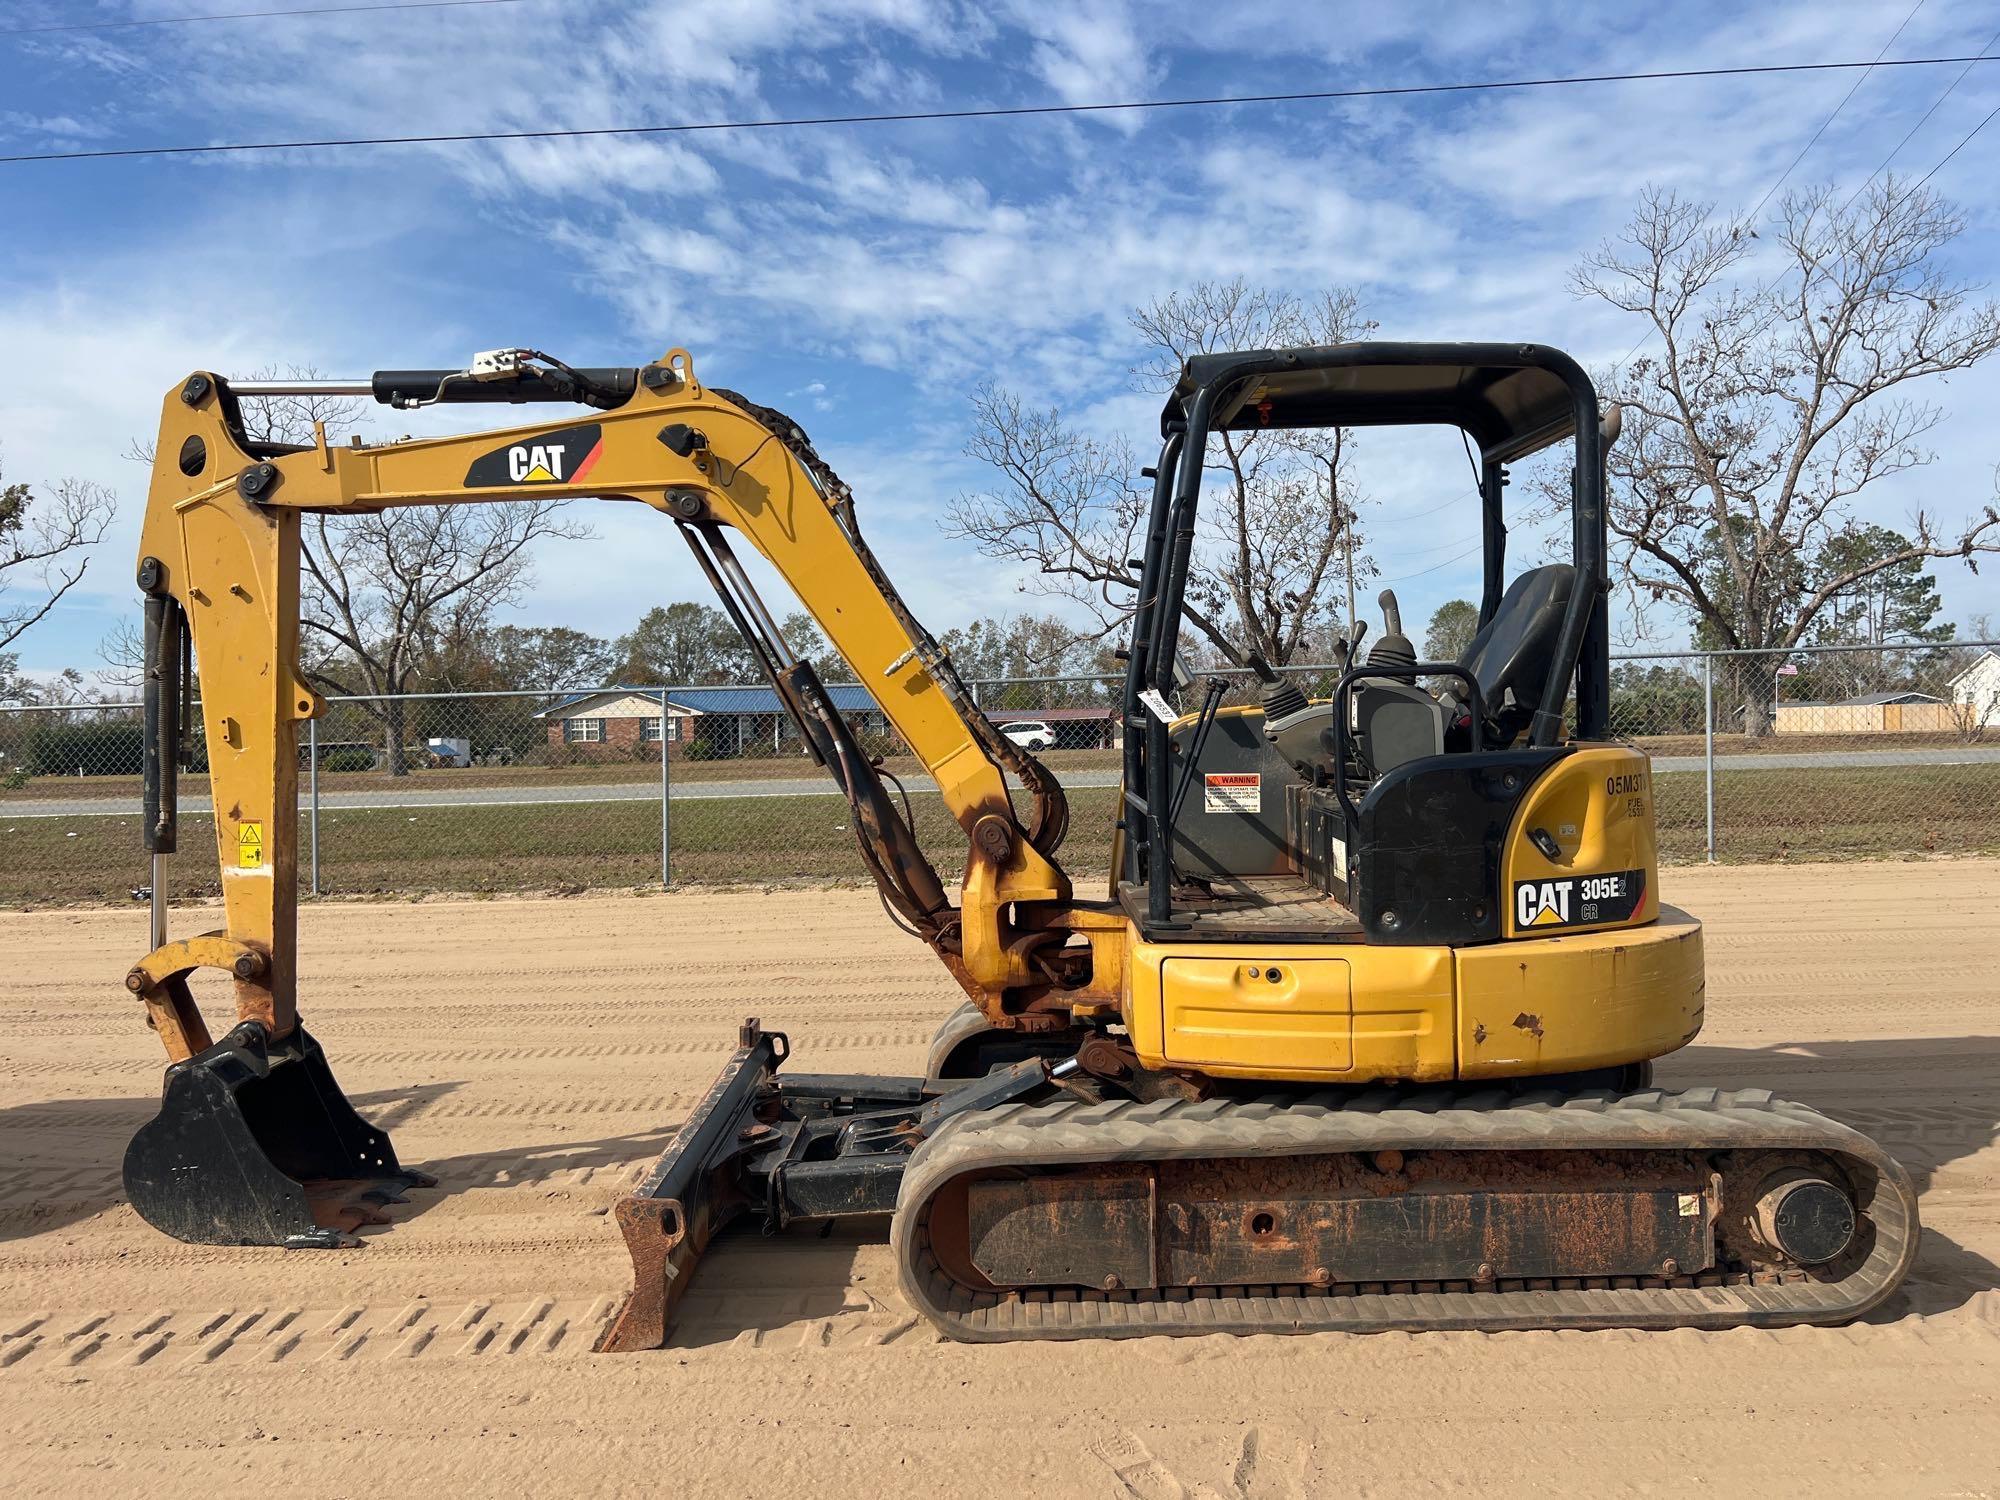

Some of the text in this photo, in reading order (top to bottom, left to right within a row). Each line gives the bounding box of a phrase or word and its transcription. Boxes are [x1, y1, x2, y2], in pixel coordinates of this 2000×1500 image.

[508, 445, 565, 482] CAT
[1221, 776, 1256, 784] WARNING
[1517, 876, 1626, 926] CAT 305E2
[1581, 903, 1598, 920] CR
